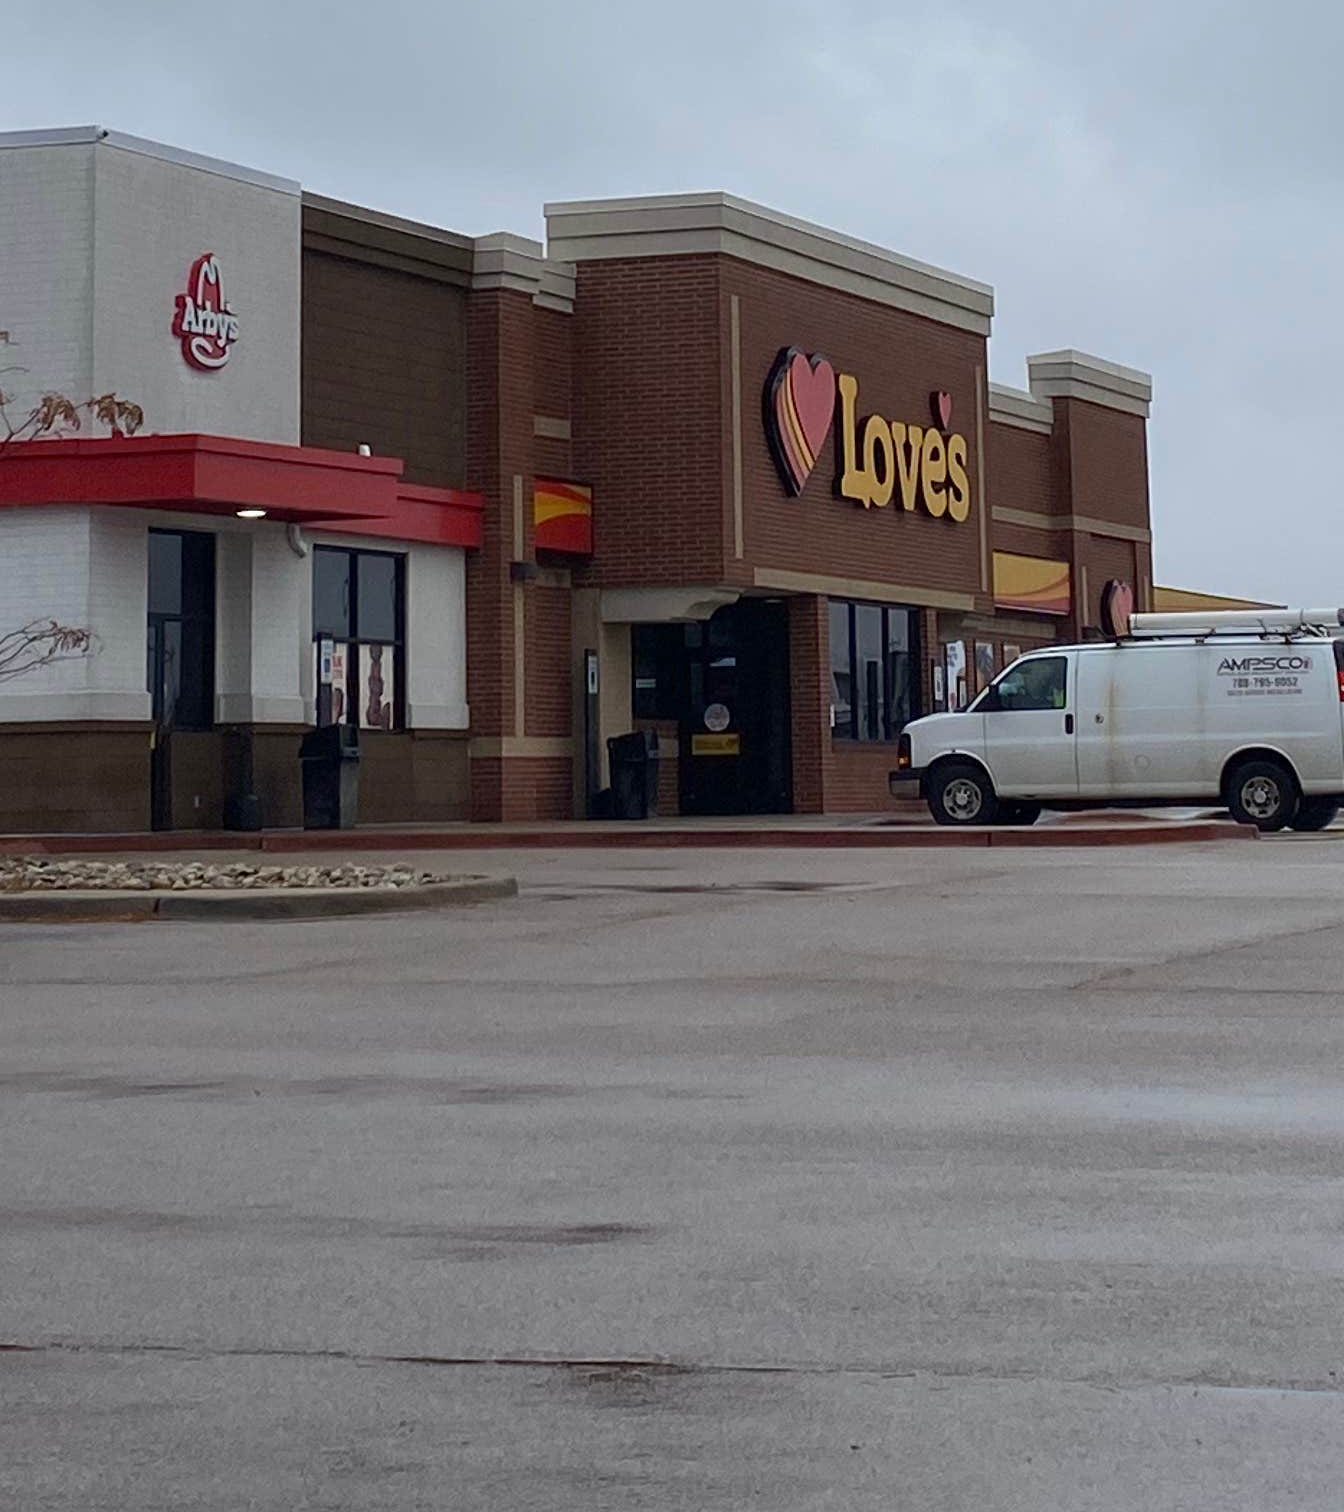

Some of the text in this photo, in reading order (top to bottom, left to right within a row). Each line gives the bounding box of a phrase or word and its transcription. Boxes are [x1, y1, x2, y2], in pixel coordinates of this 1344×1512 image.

[182, 296, 239, 348] Arby's
[838, 373, 970, 523] Love's
[1217, 656, 1304, 675] AMPSCO
